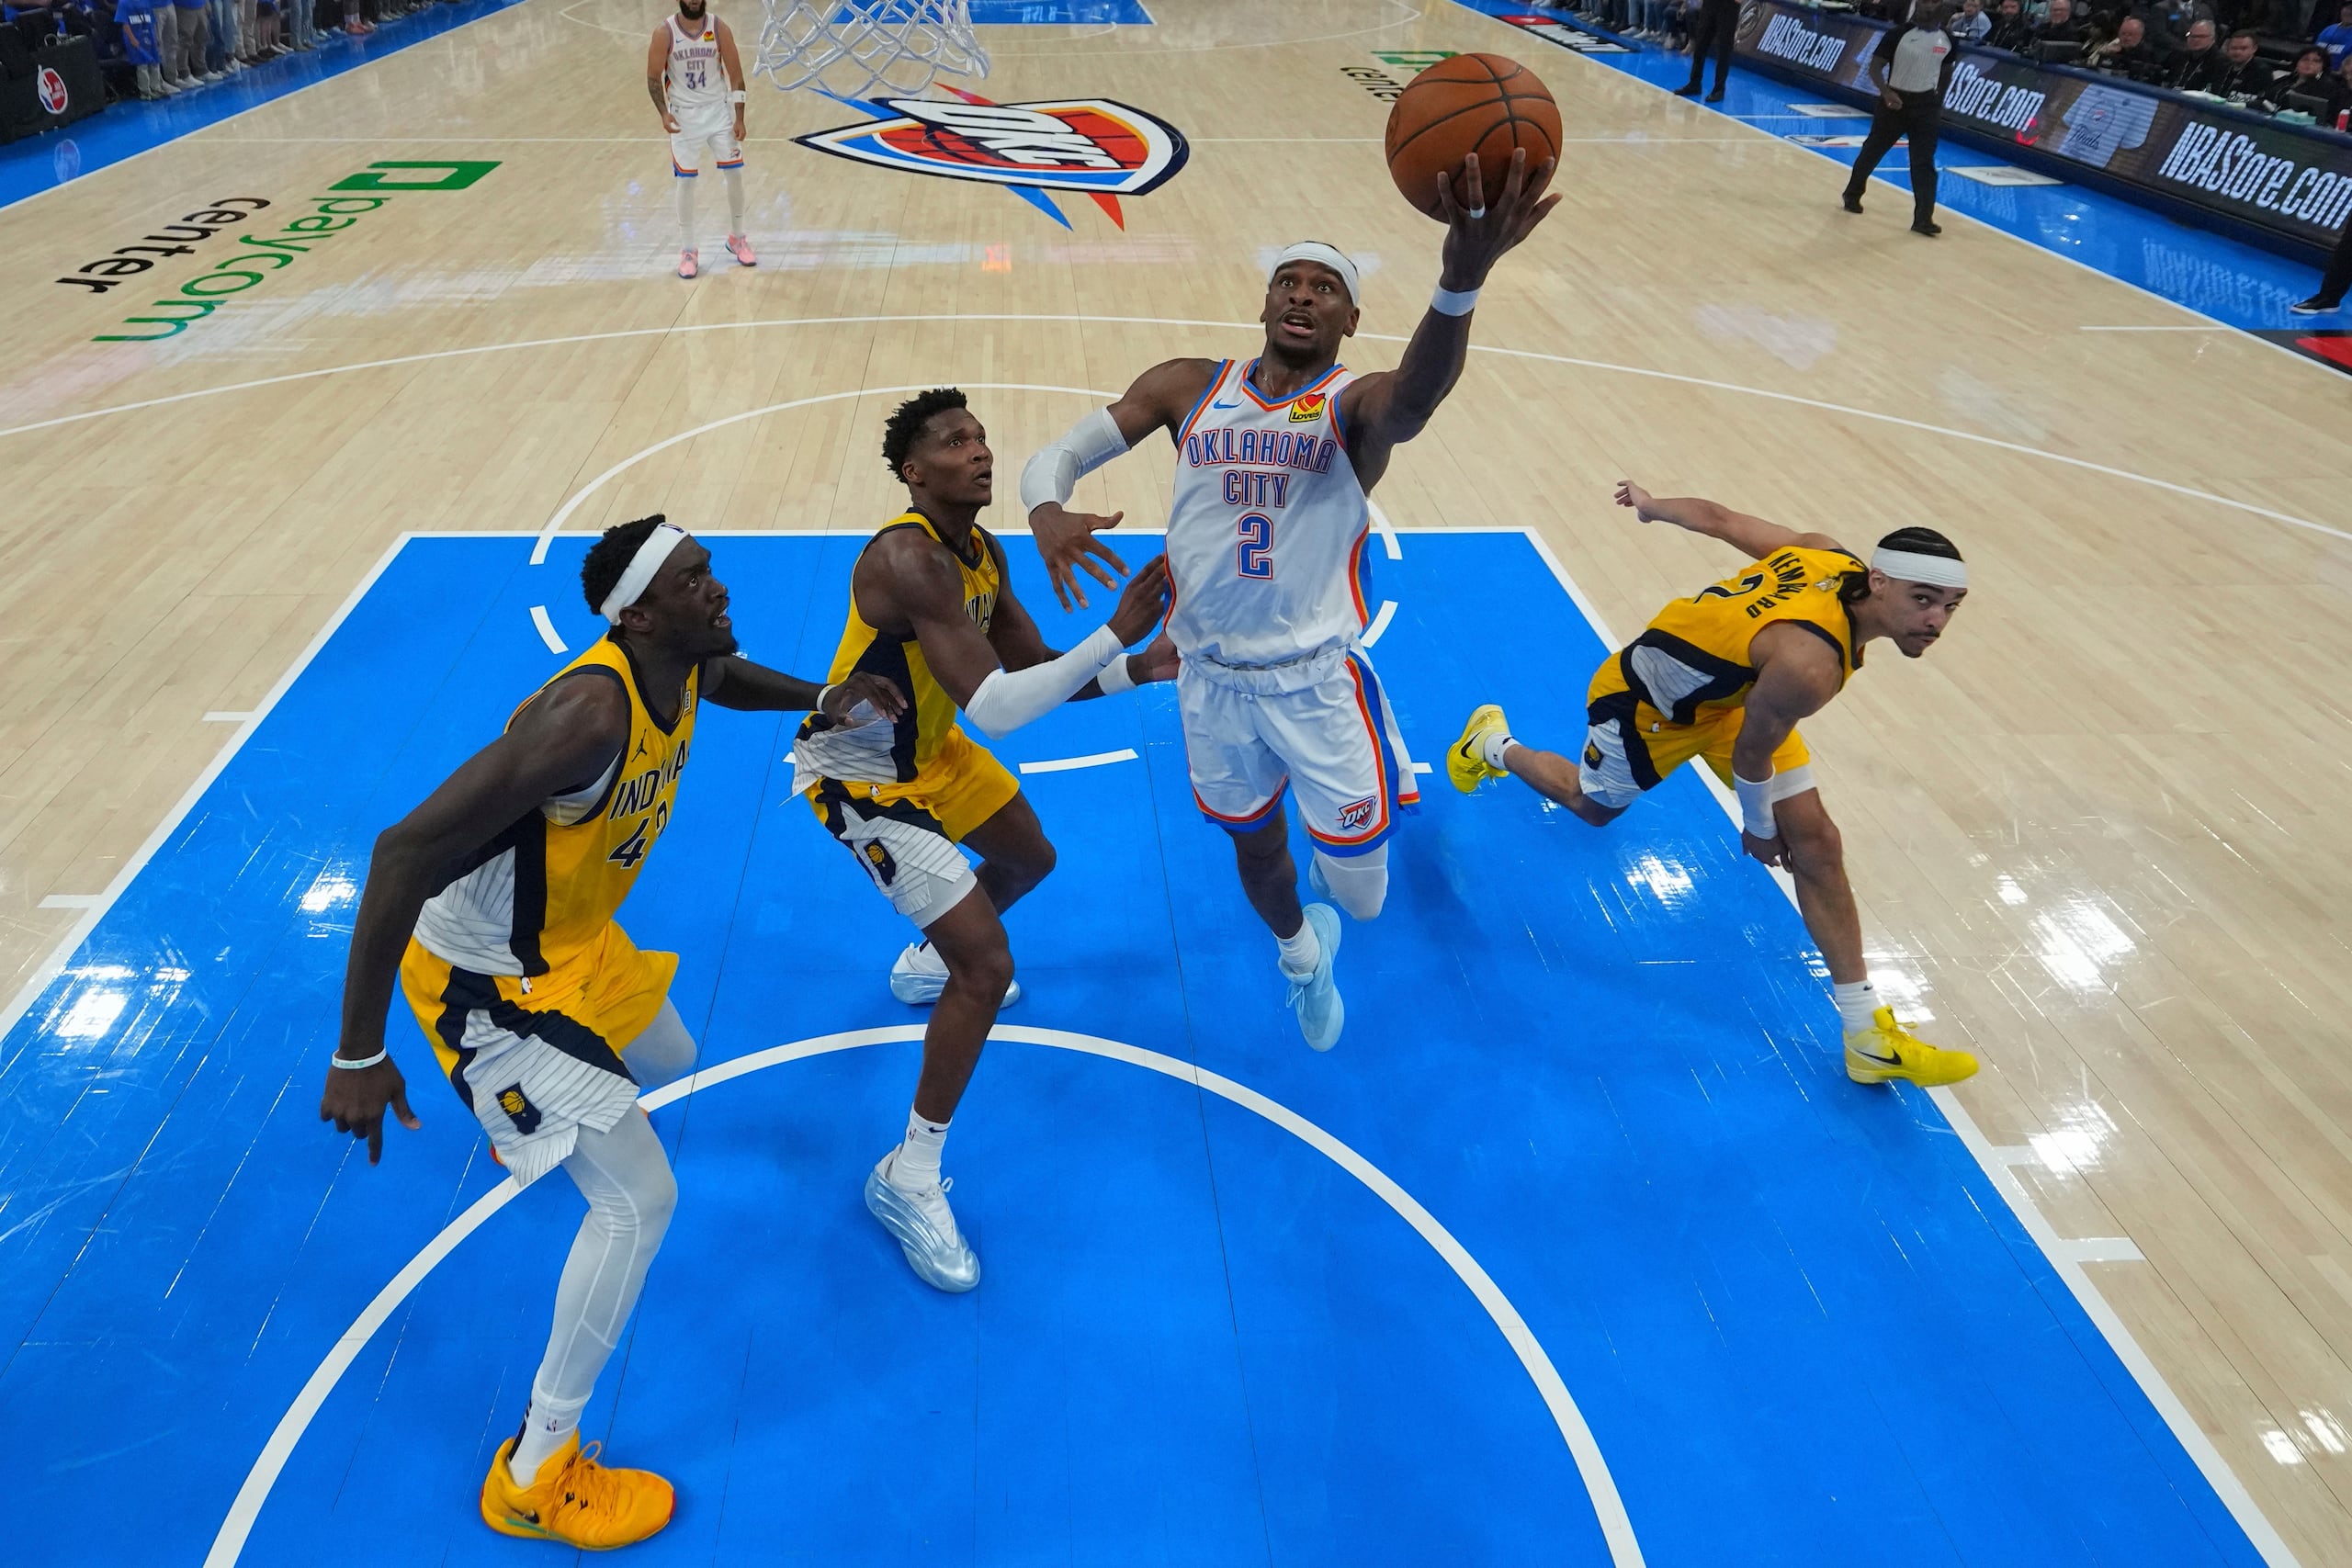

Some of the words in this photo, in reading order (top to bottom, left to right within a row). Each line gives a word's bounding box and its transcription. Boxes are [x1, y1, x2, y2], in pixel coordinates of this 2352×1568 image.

[673, 46, 718, 62] OKLAHOMA
[686, 59, 707, 71] CITY
[1757, 13, 1847, 73] NBAStore.com
[685, 71, 707, 90] 34
[1943, 61, 2046, 132] Store.com
[888, 99, 1122, 169] OKC
[2158, 121, 2352, 231] NBAStore.com
[55, 197, 271, 293] center
[90, 197, 392, 342] paycom
[1185, 428, 1338, 475] OKLAHOMA
[1223, 469, 1290, 509] CITY
[1238, 513, 1274, 581] 2
